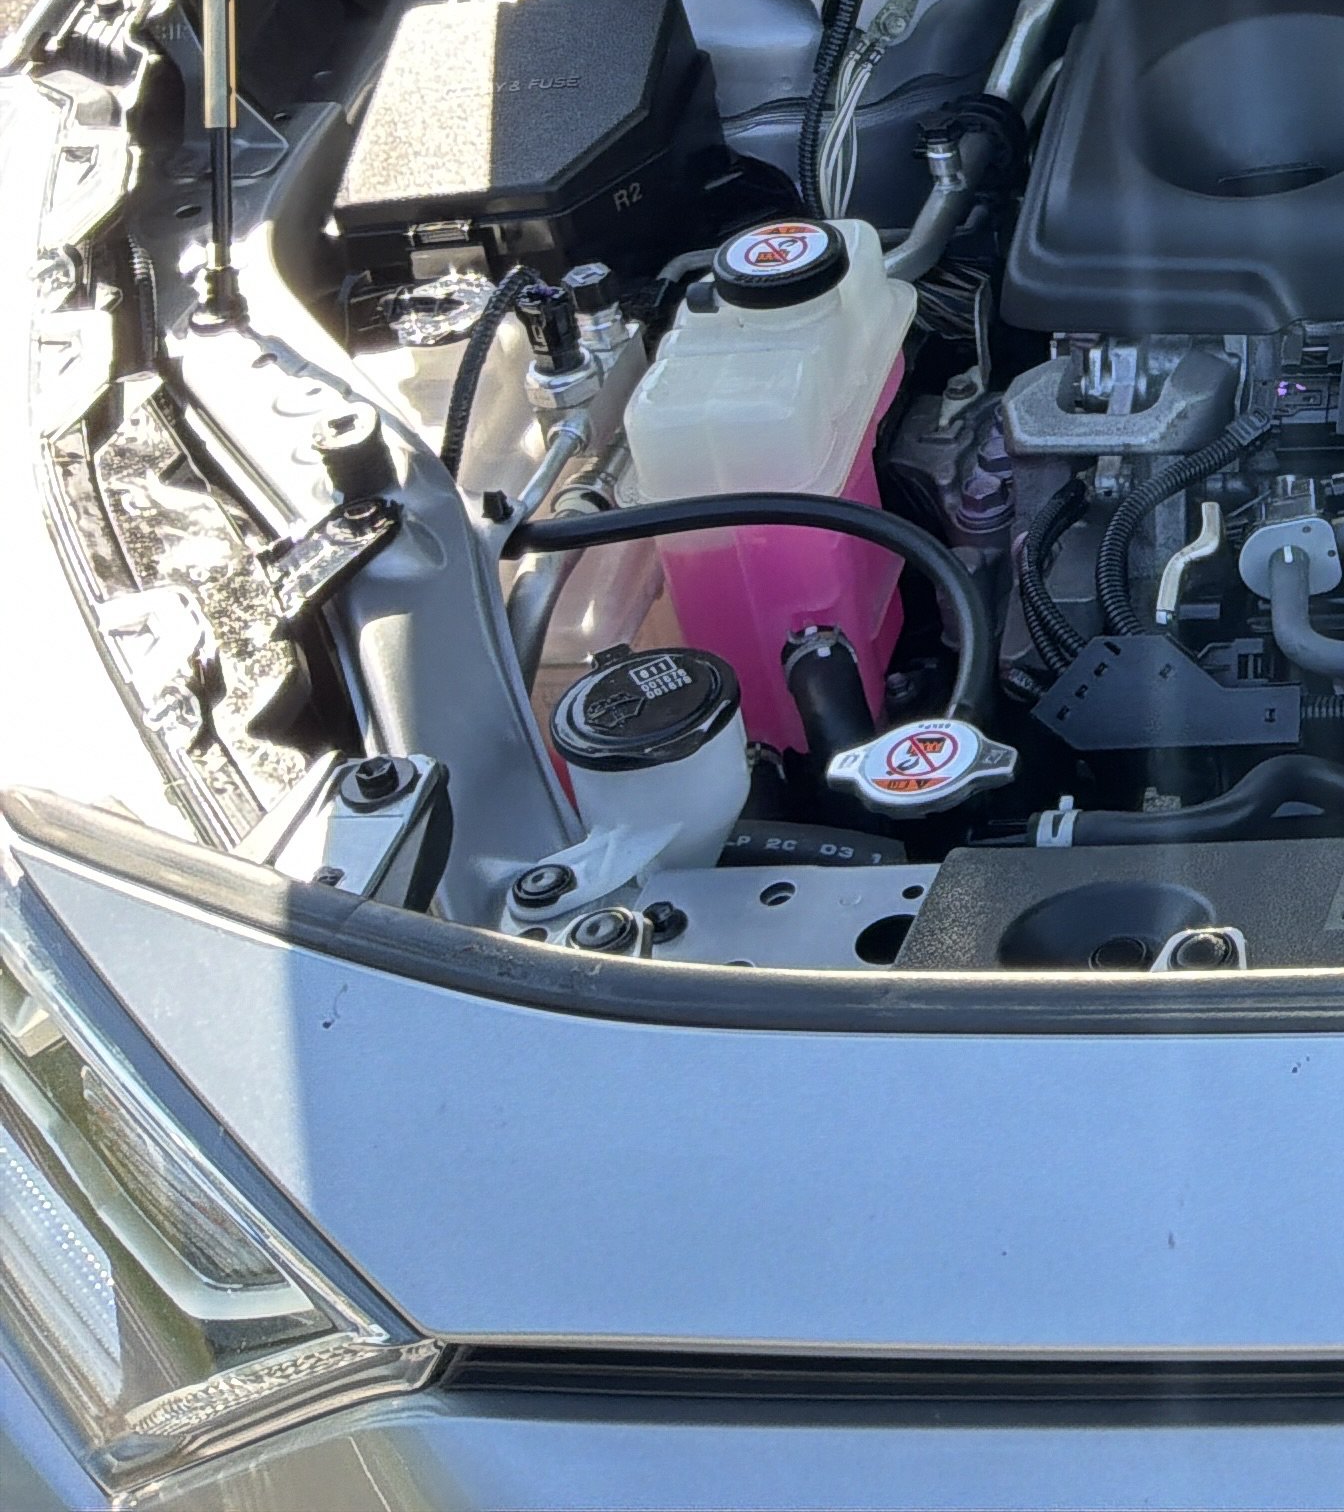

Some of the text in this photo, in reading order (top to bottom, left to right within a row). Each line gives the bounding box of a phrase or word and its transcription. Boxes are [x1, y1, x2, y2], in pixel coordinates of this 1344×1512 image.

[508, 80, 521, 92] &
[528, 76, 581, 89] FUSE
[613, 182, 643, 212] R2
